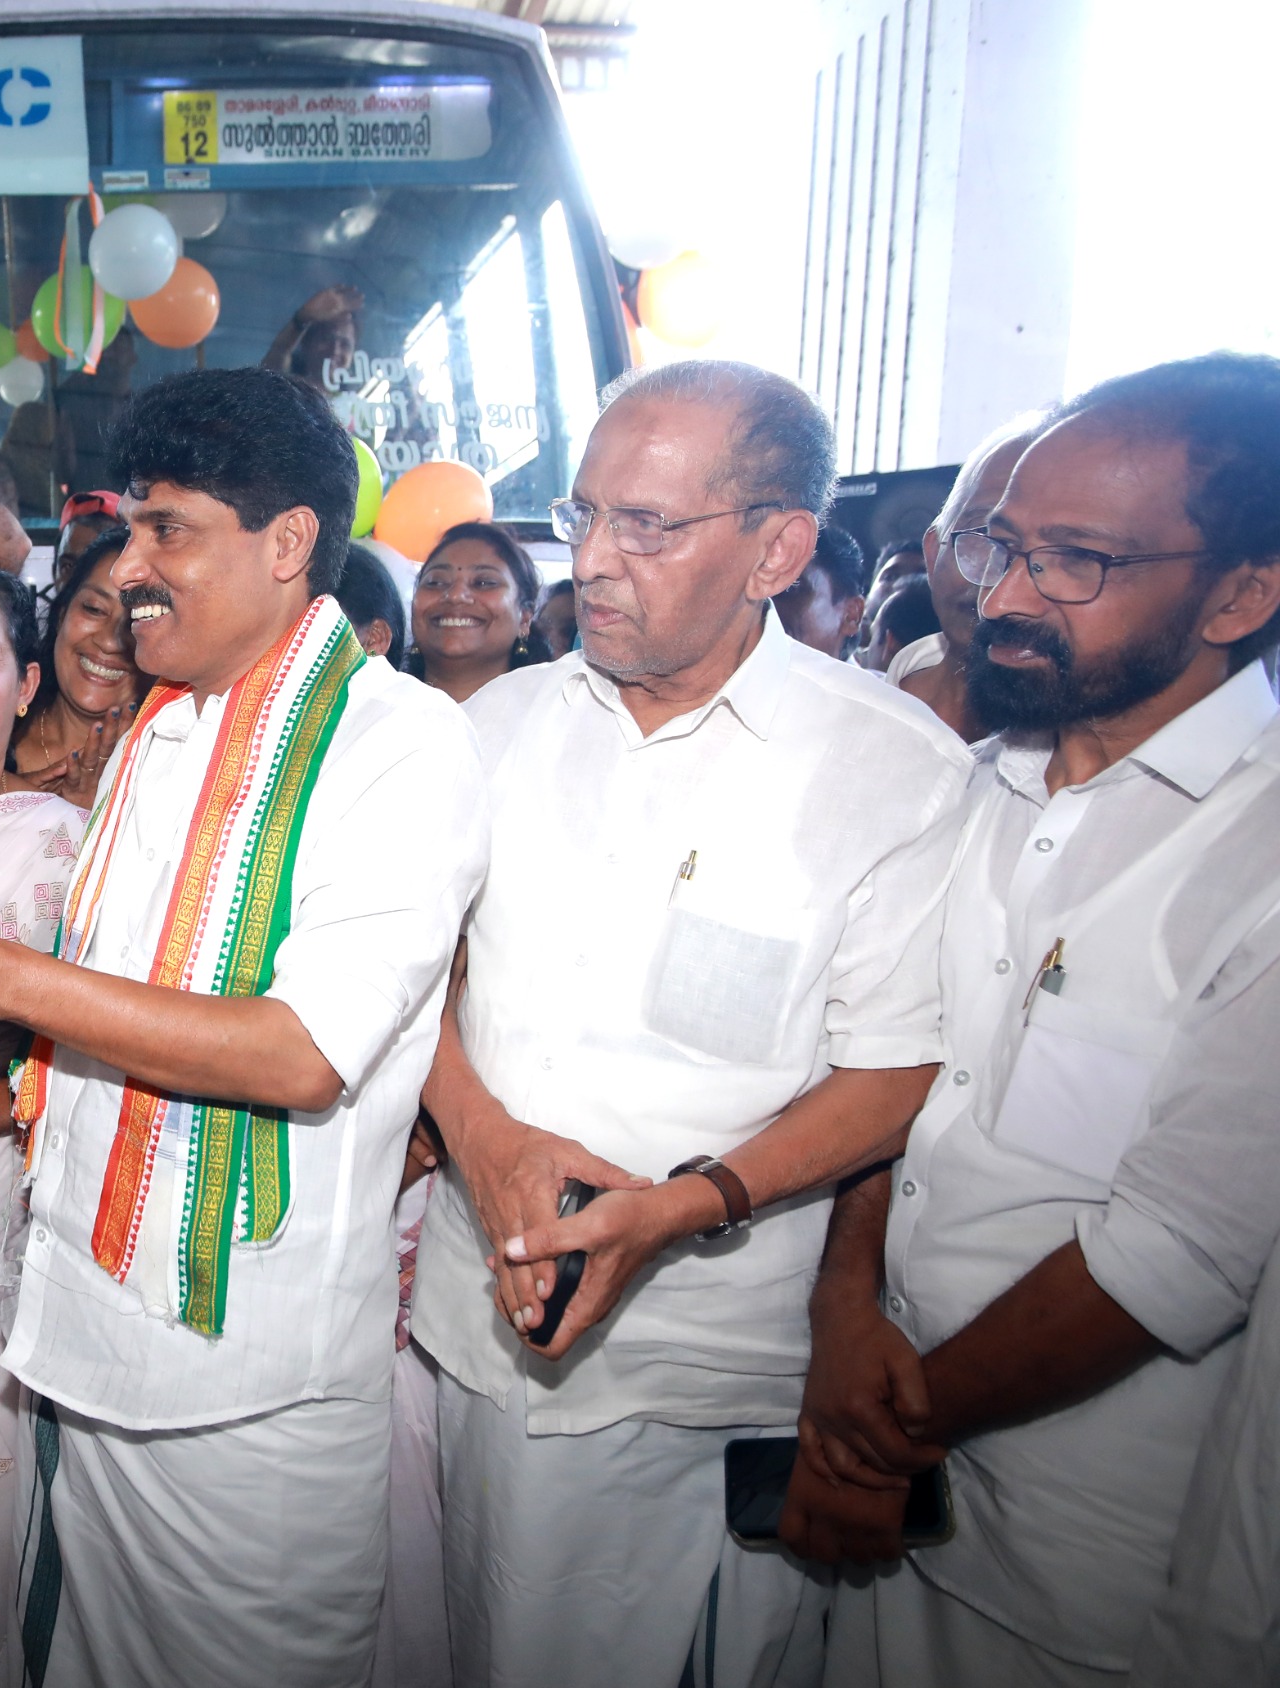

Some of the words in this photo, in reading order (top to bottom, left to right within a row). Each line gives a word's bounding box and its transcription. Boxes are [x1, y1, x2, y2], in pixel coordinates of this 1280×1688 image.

[181, 131, 208, 157] 12
[223, 115, 338, 153] സുൽത്താൻ
[348, 113, 431, 147] ബത്തേരി
[264, 147, 343, 157] SULTHAN
[351, 146, 431, 156] BATHERY
